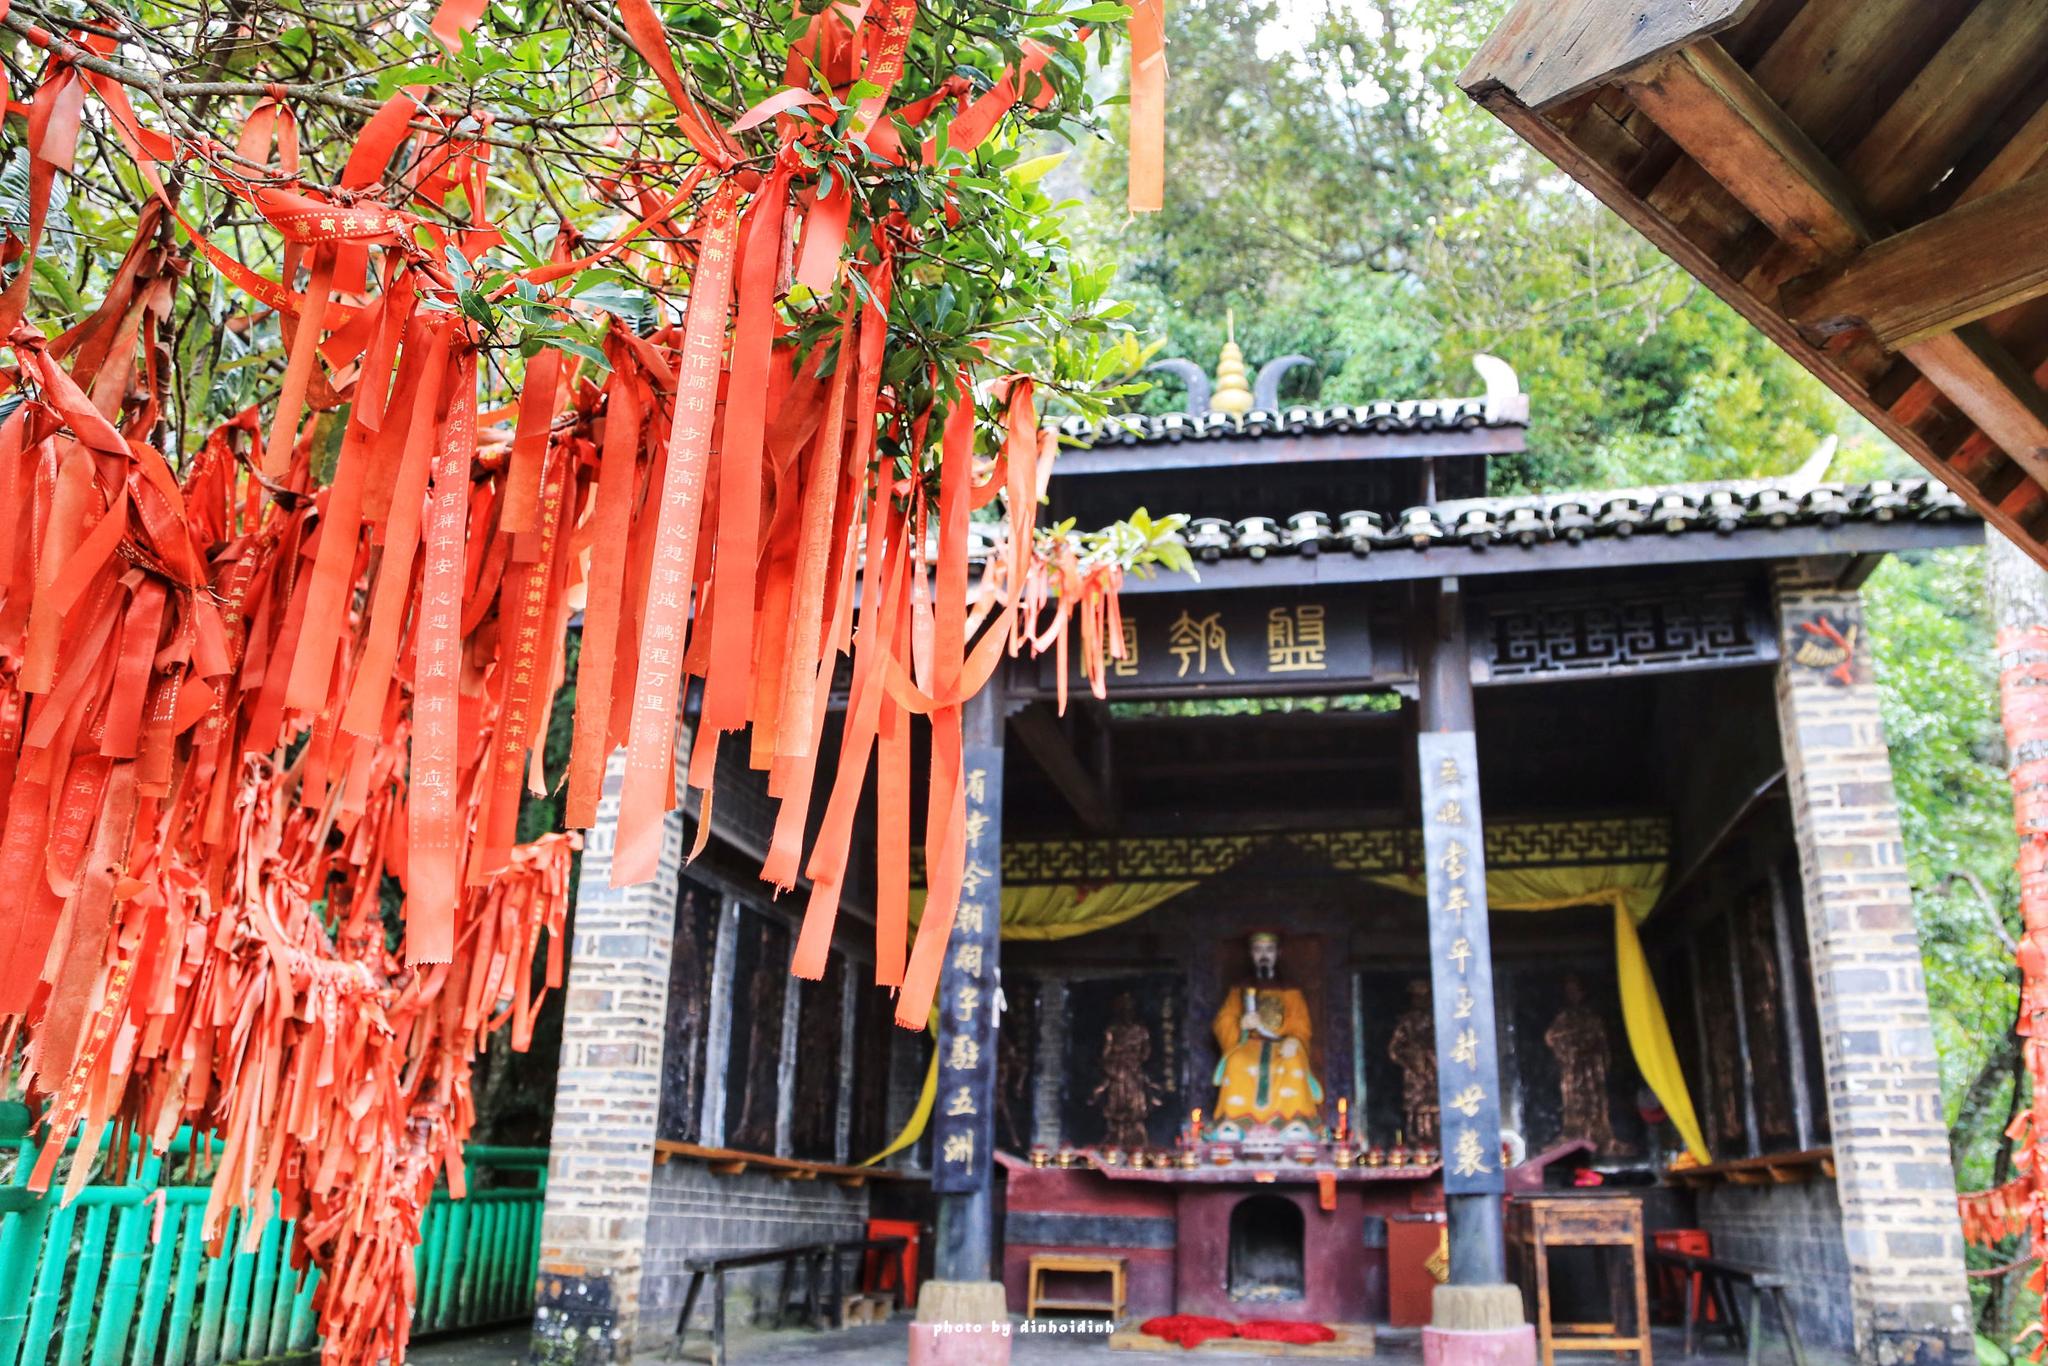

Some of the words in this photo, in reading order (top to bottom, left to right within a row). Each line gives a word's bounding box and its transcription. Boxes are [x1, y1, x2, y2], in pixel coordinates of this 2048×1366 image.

[875, 6, 911, 73] 有求必应
[687, 336, 713, 412] 工作顺利
[443, 400, 465, 476] 消灾免难
[672, 427, 701, 507] 步步高升
[434, 492, 456, 575] 吉祥平安
[657, 524, 688, 609] 心想事成
[426, 592, 450, 677] 心想事成
[643, 624, 674, 711] 鹏程万里
[505, 698, 527, 752] 一生平安
